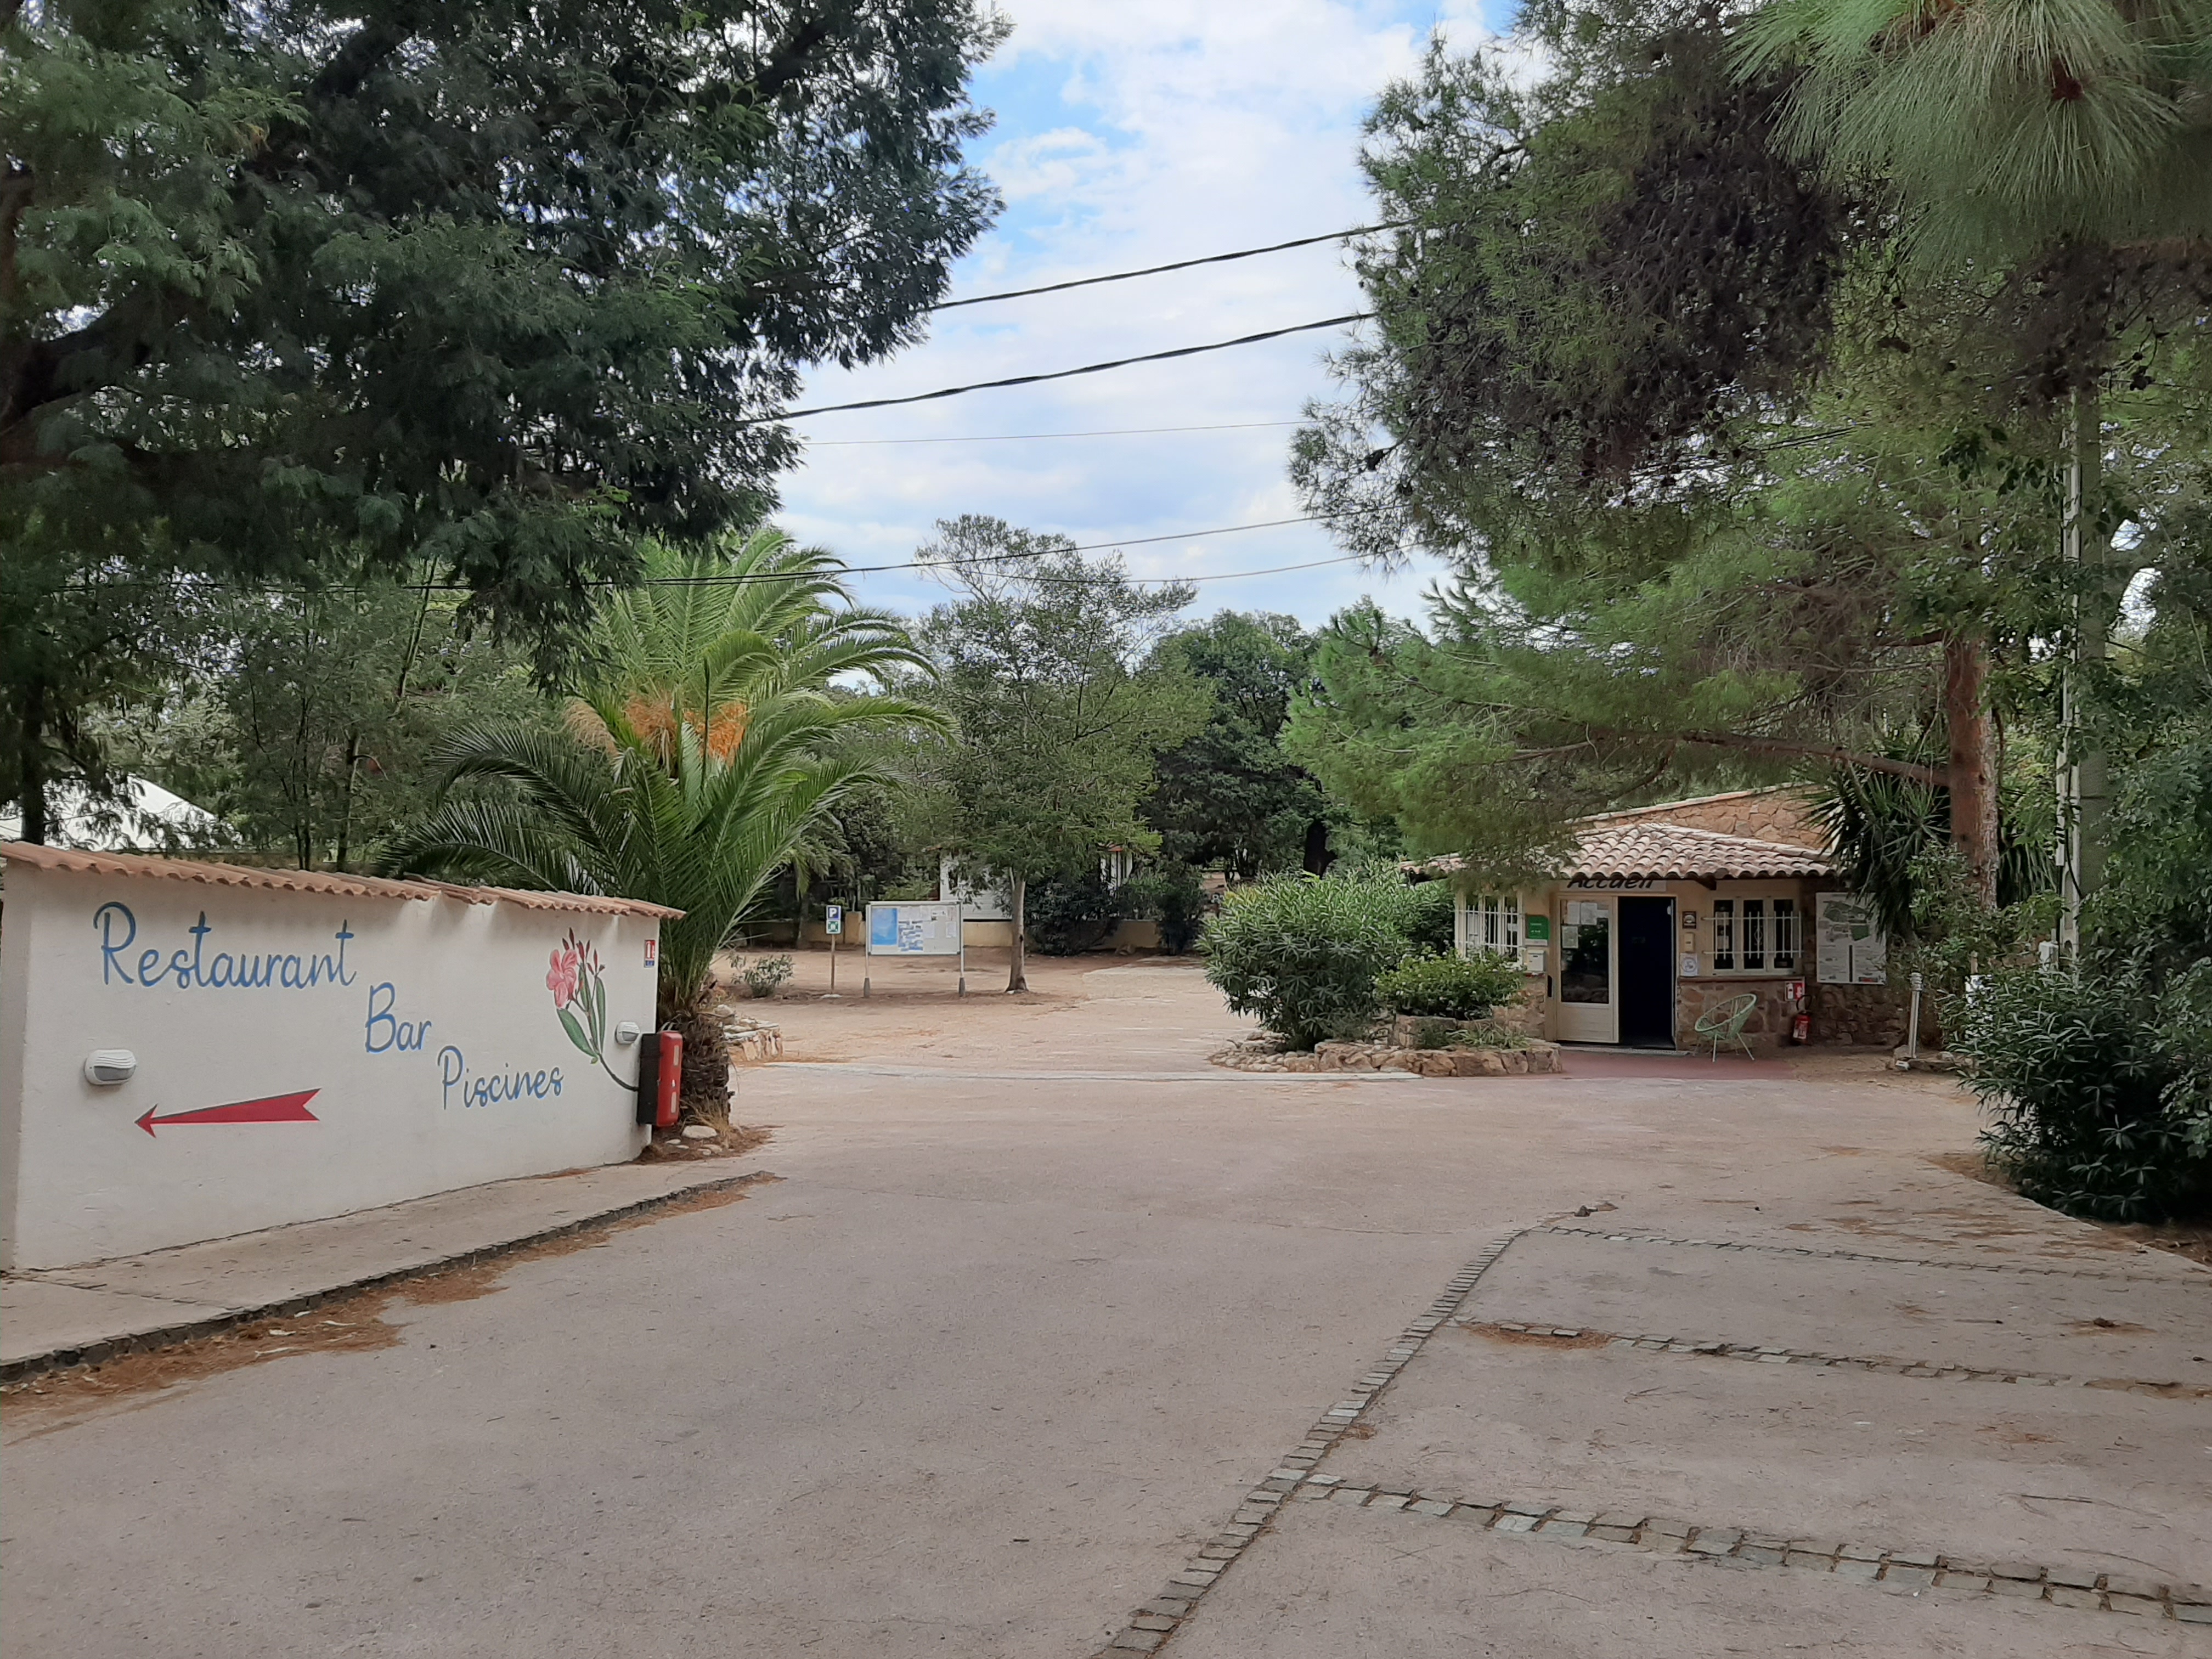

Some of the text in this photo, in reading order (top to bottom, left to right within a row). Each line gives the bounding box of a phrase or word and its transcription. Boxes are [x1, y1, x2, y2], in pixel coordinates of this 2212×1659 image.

[93, 901, 357, 989] Restaurant
[829, 907, 837, 918] P
[365, 982, 432, 1053] Bar
[437, 1045, 564, 1110] Piscines
